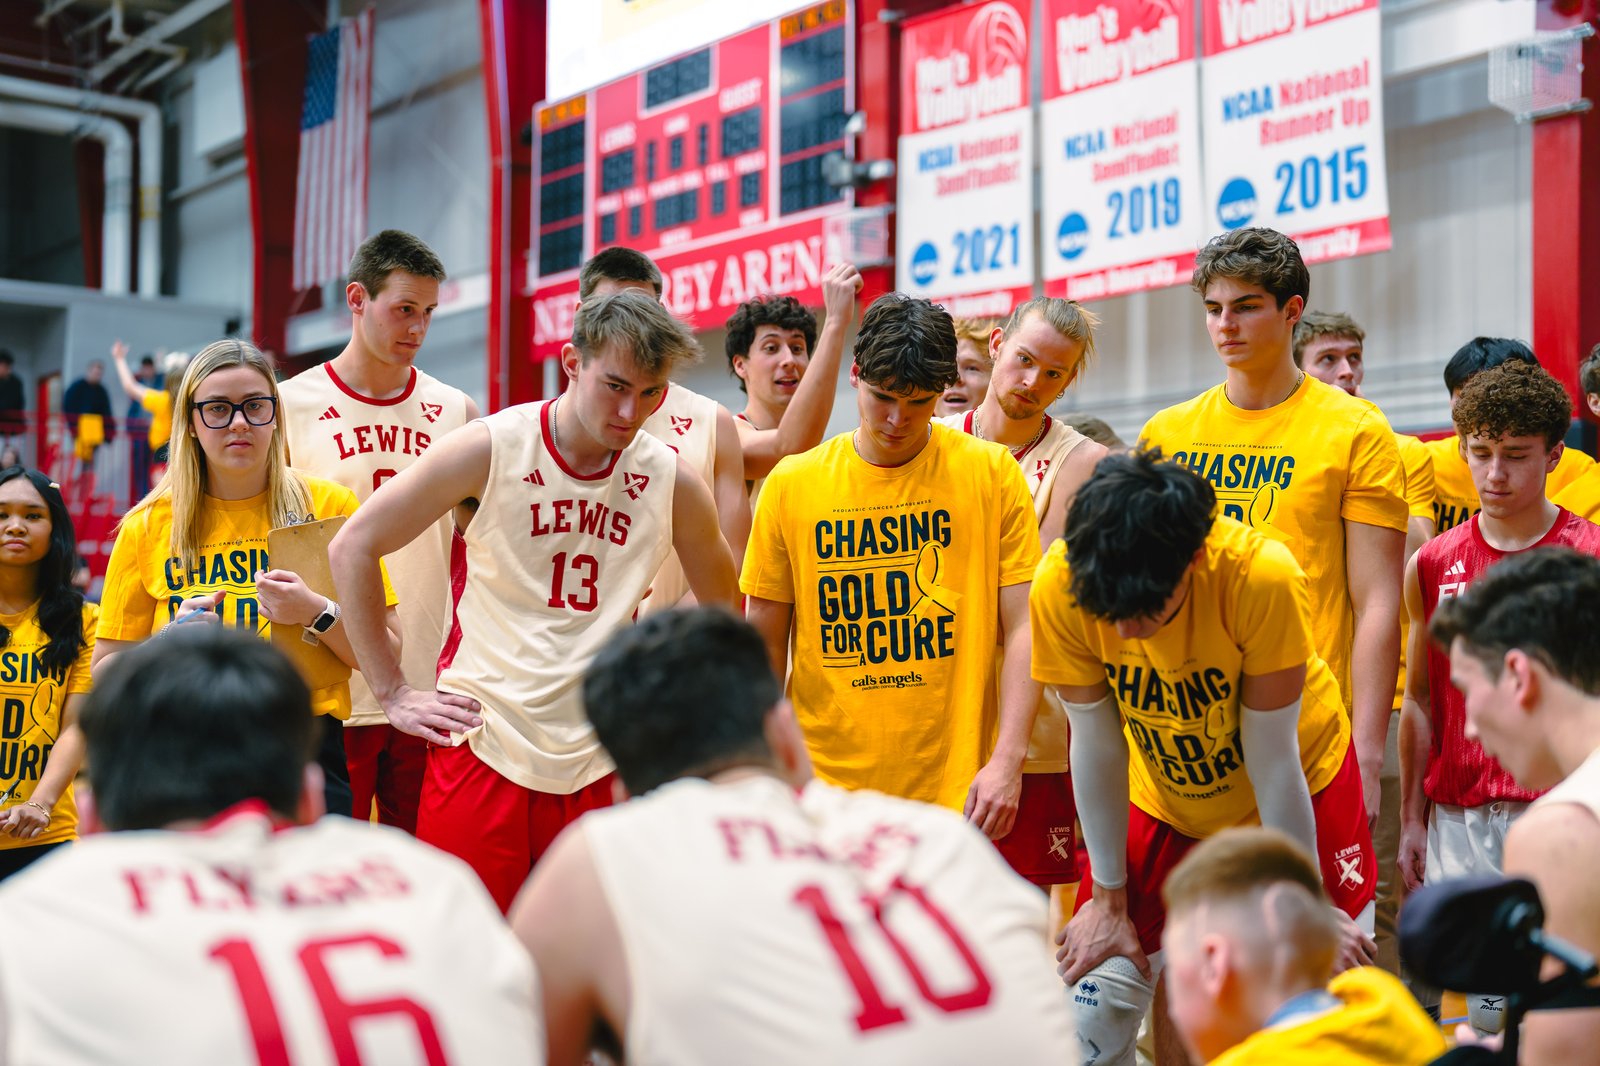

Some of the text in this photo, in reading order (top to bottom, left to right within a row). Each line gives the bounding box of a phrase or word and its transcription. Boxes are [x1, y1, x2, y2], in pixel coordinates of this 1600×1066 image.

[1056, 14, 1180, 92] Volleyball
[1222, 57, 1369, 124] NCAA National
[1260, 98, 1370, 146] Runner Up
[1275, 144, 1368, 216] 2015
[1107, 175, 1181, 239] 2019
[953, 222, 1020, 277] 2021
[333, 424, 432, 461] LEWIS
[530, 499, 632, 546] LEWIS
[815, 509, 951, 560] CHASING
[547, 551, 599, 613] 13
[818, 570, 910, 623] GOLD
[820, 614, 955, 667] FOR A CURE
[851, 671, 923, 689] cal's angels
[1129, 717, 1206, 763] OLD
[1050, 826, 1070, 834] LEWIS
[1334, 843, 1361, 860] LEWIS
[795, 873, 994, 1034] 10
[205, 931, 450, 1066] 16
